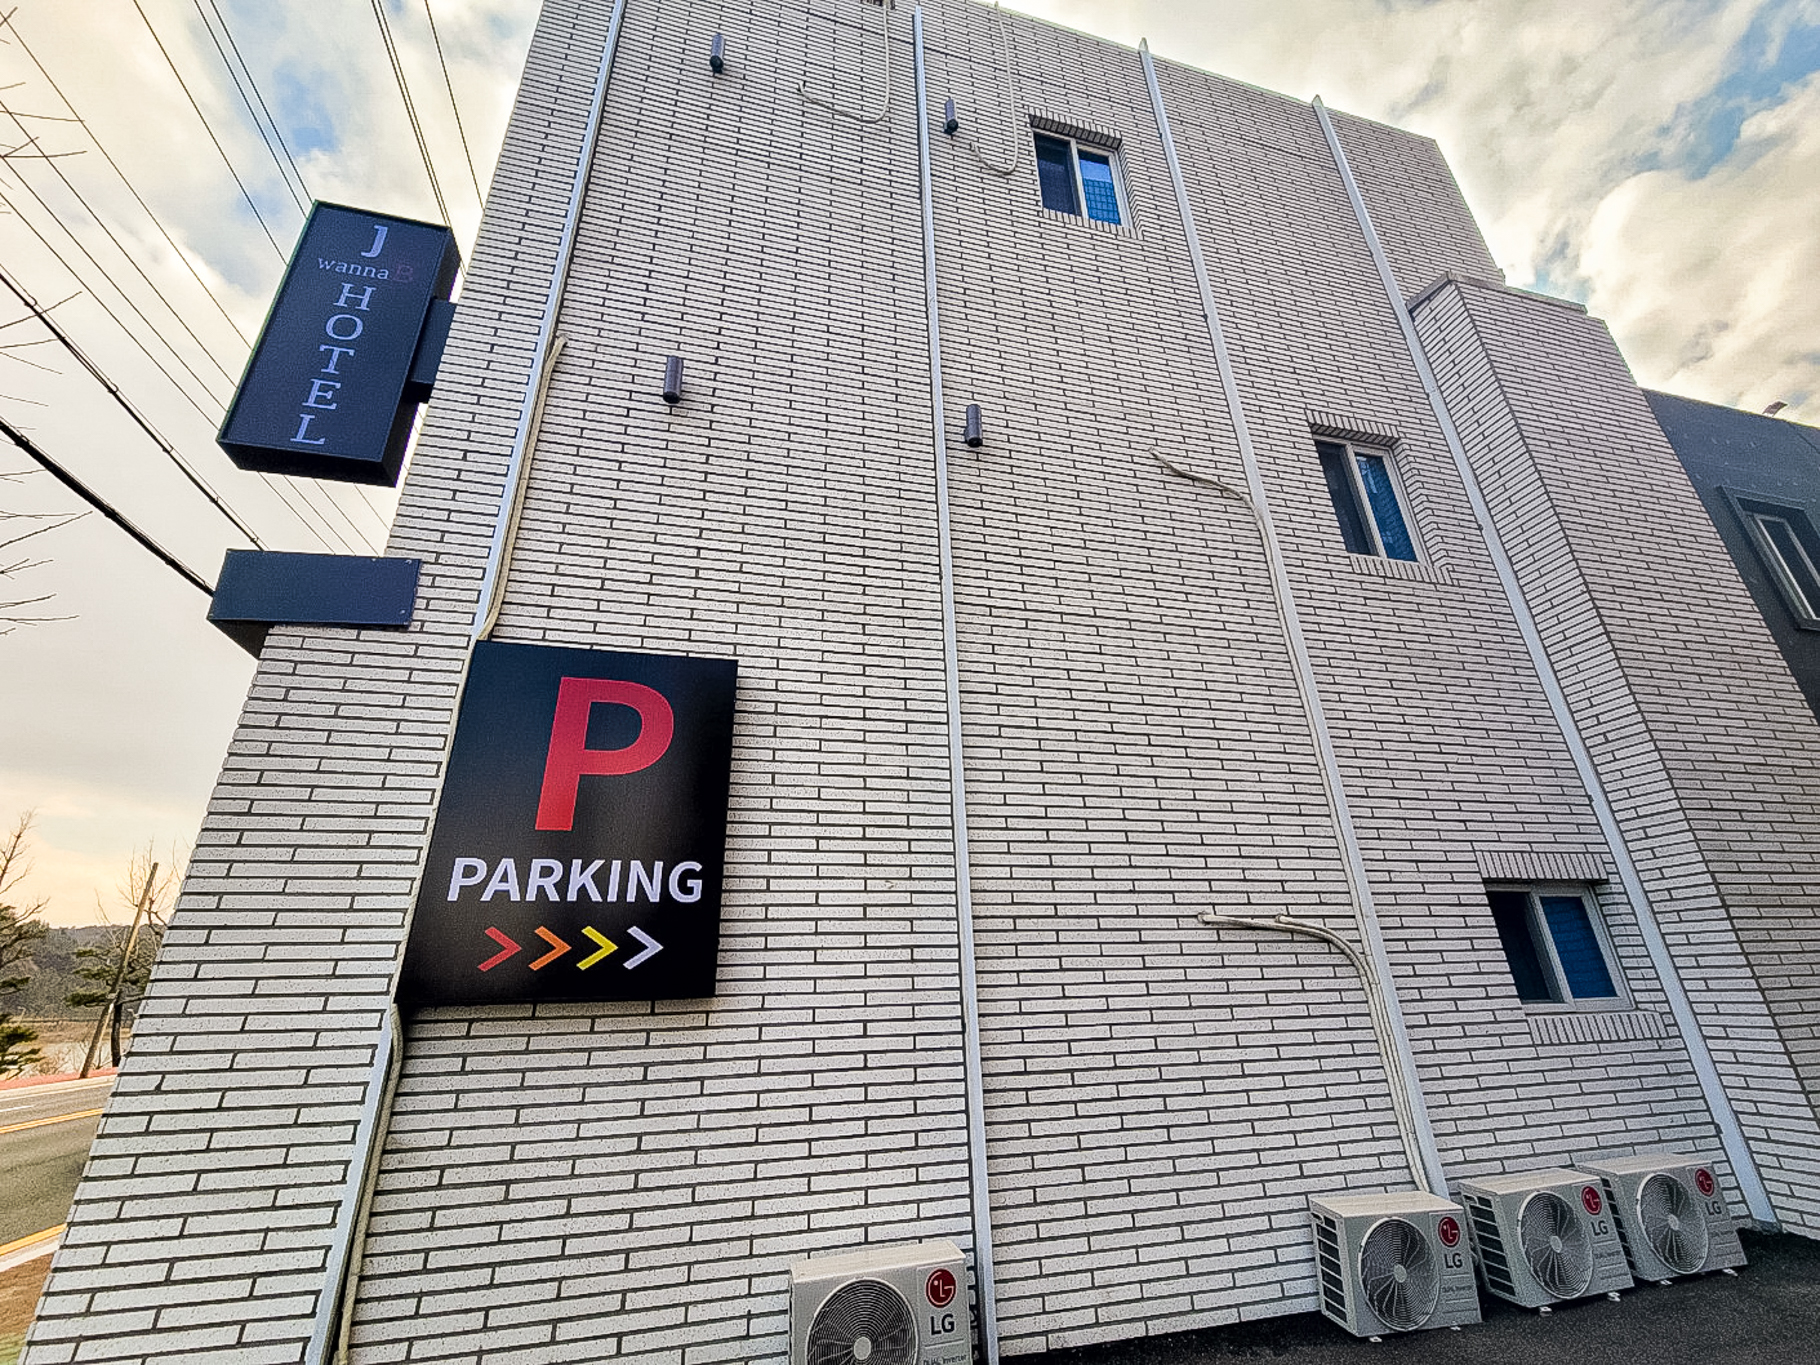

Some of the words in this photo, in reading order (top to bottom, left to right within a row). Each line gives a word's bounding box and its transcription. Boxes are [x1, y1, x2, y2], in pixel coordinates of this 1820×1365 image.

[360, 224, 389, 258] J
[289, 282, 377, 446] HOTEL
[534, 676, 675, 832] P
[446, 857, 704, 903] PARKING
[1704, 1200, 1722, 1216] LG
[1590, 1220, 1609, 1237] LG
[1443, 1252, 1463, 1269] LG
[930, 1313, 955, 1336] LG
